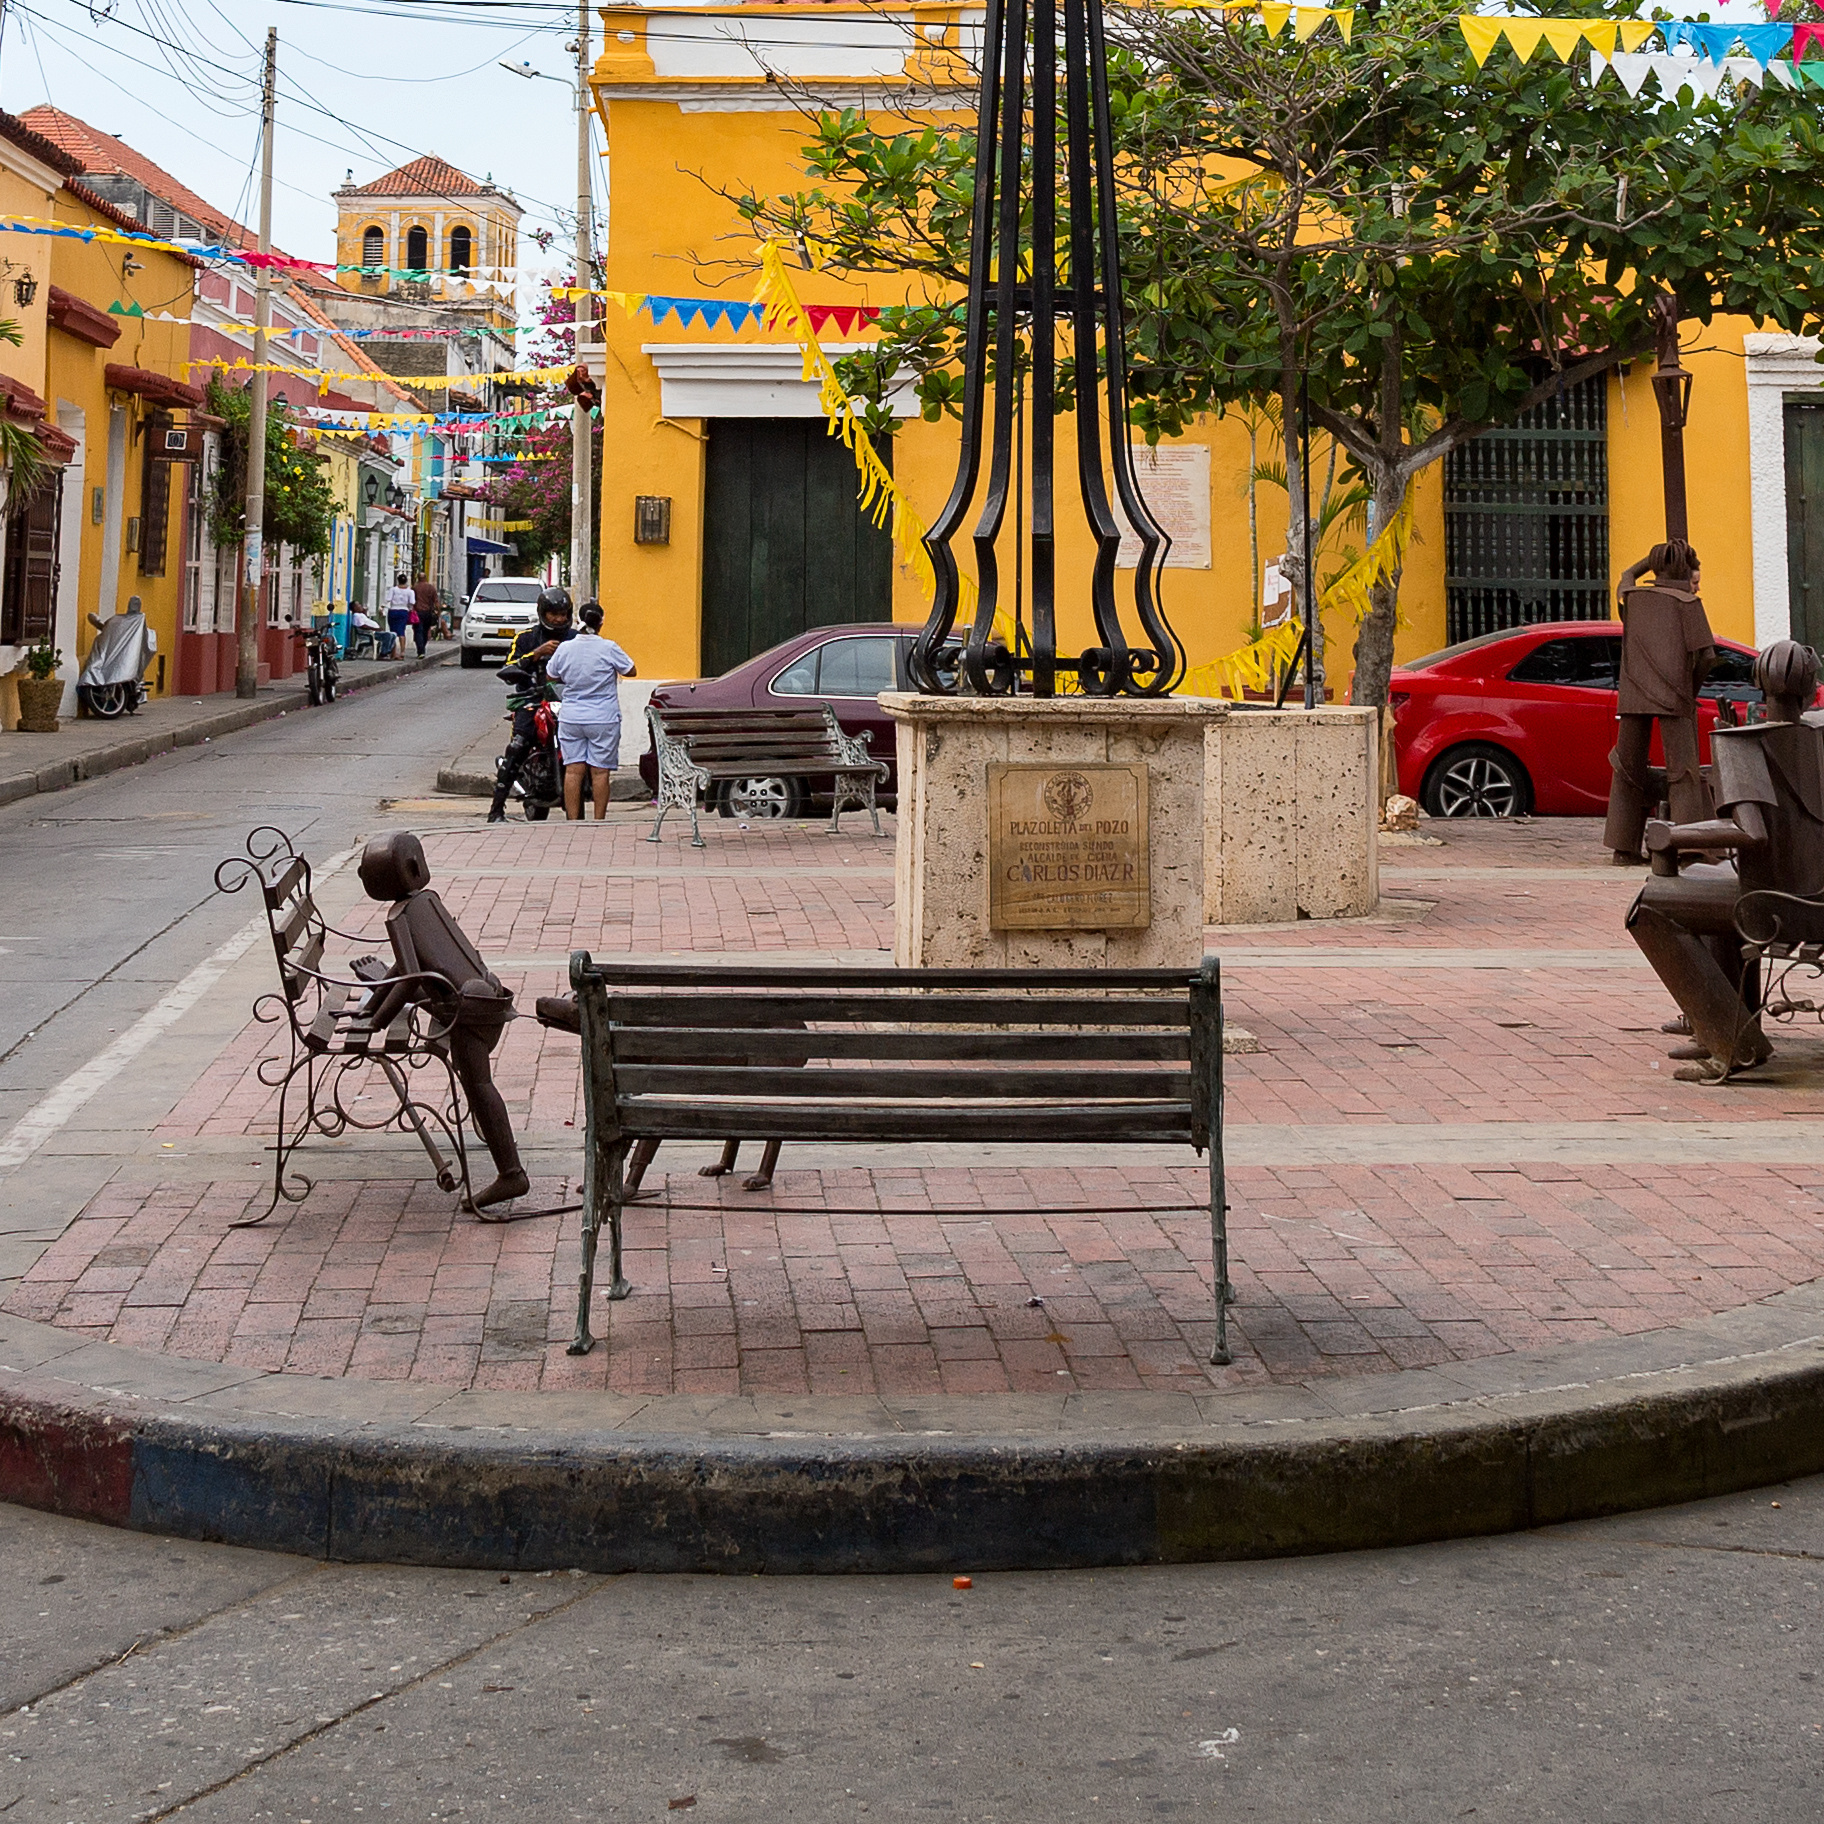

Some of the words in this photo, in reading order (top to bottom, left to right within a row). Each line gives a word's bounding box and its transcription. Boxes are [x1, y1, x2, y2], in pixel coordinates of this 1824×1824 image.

[1010, 821, 1077, 835] PLAZOLETA
[1096, 820, 1129, 835] POZO
[1083, 841, 1114, 851] SIENDO
[1028, 852, 1067, 863] ALCALDE
[1007, 864, 1079, 882] CARLOS
